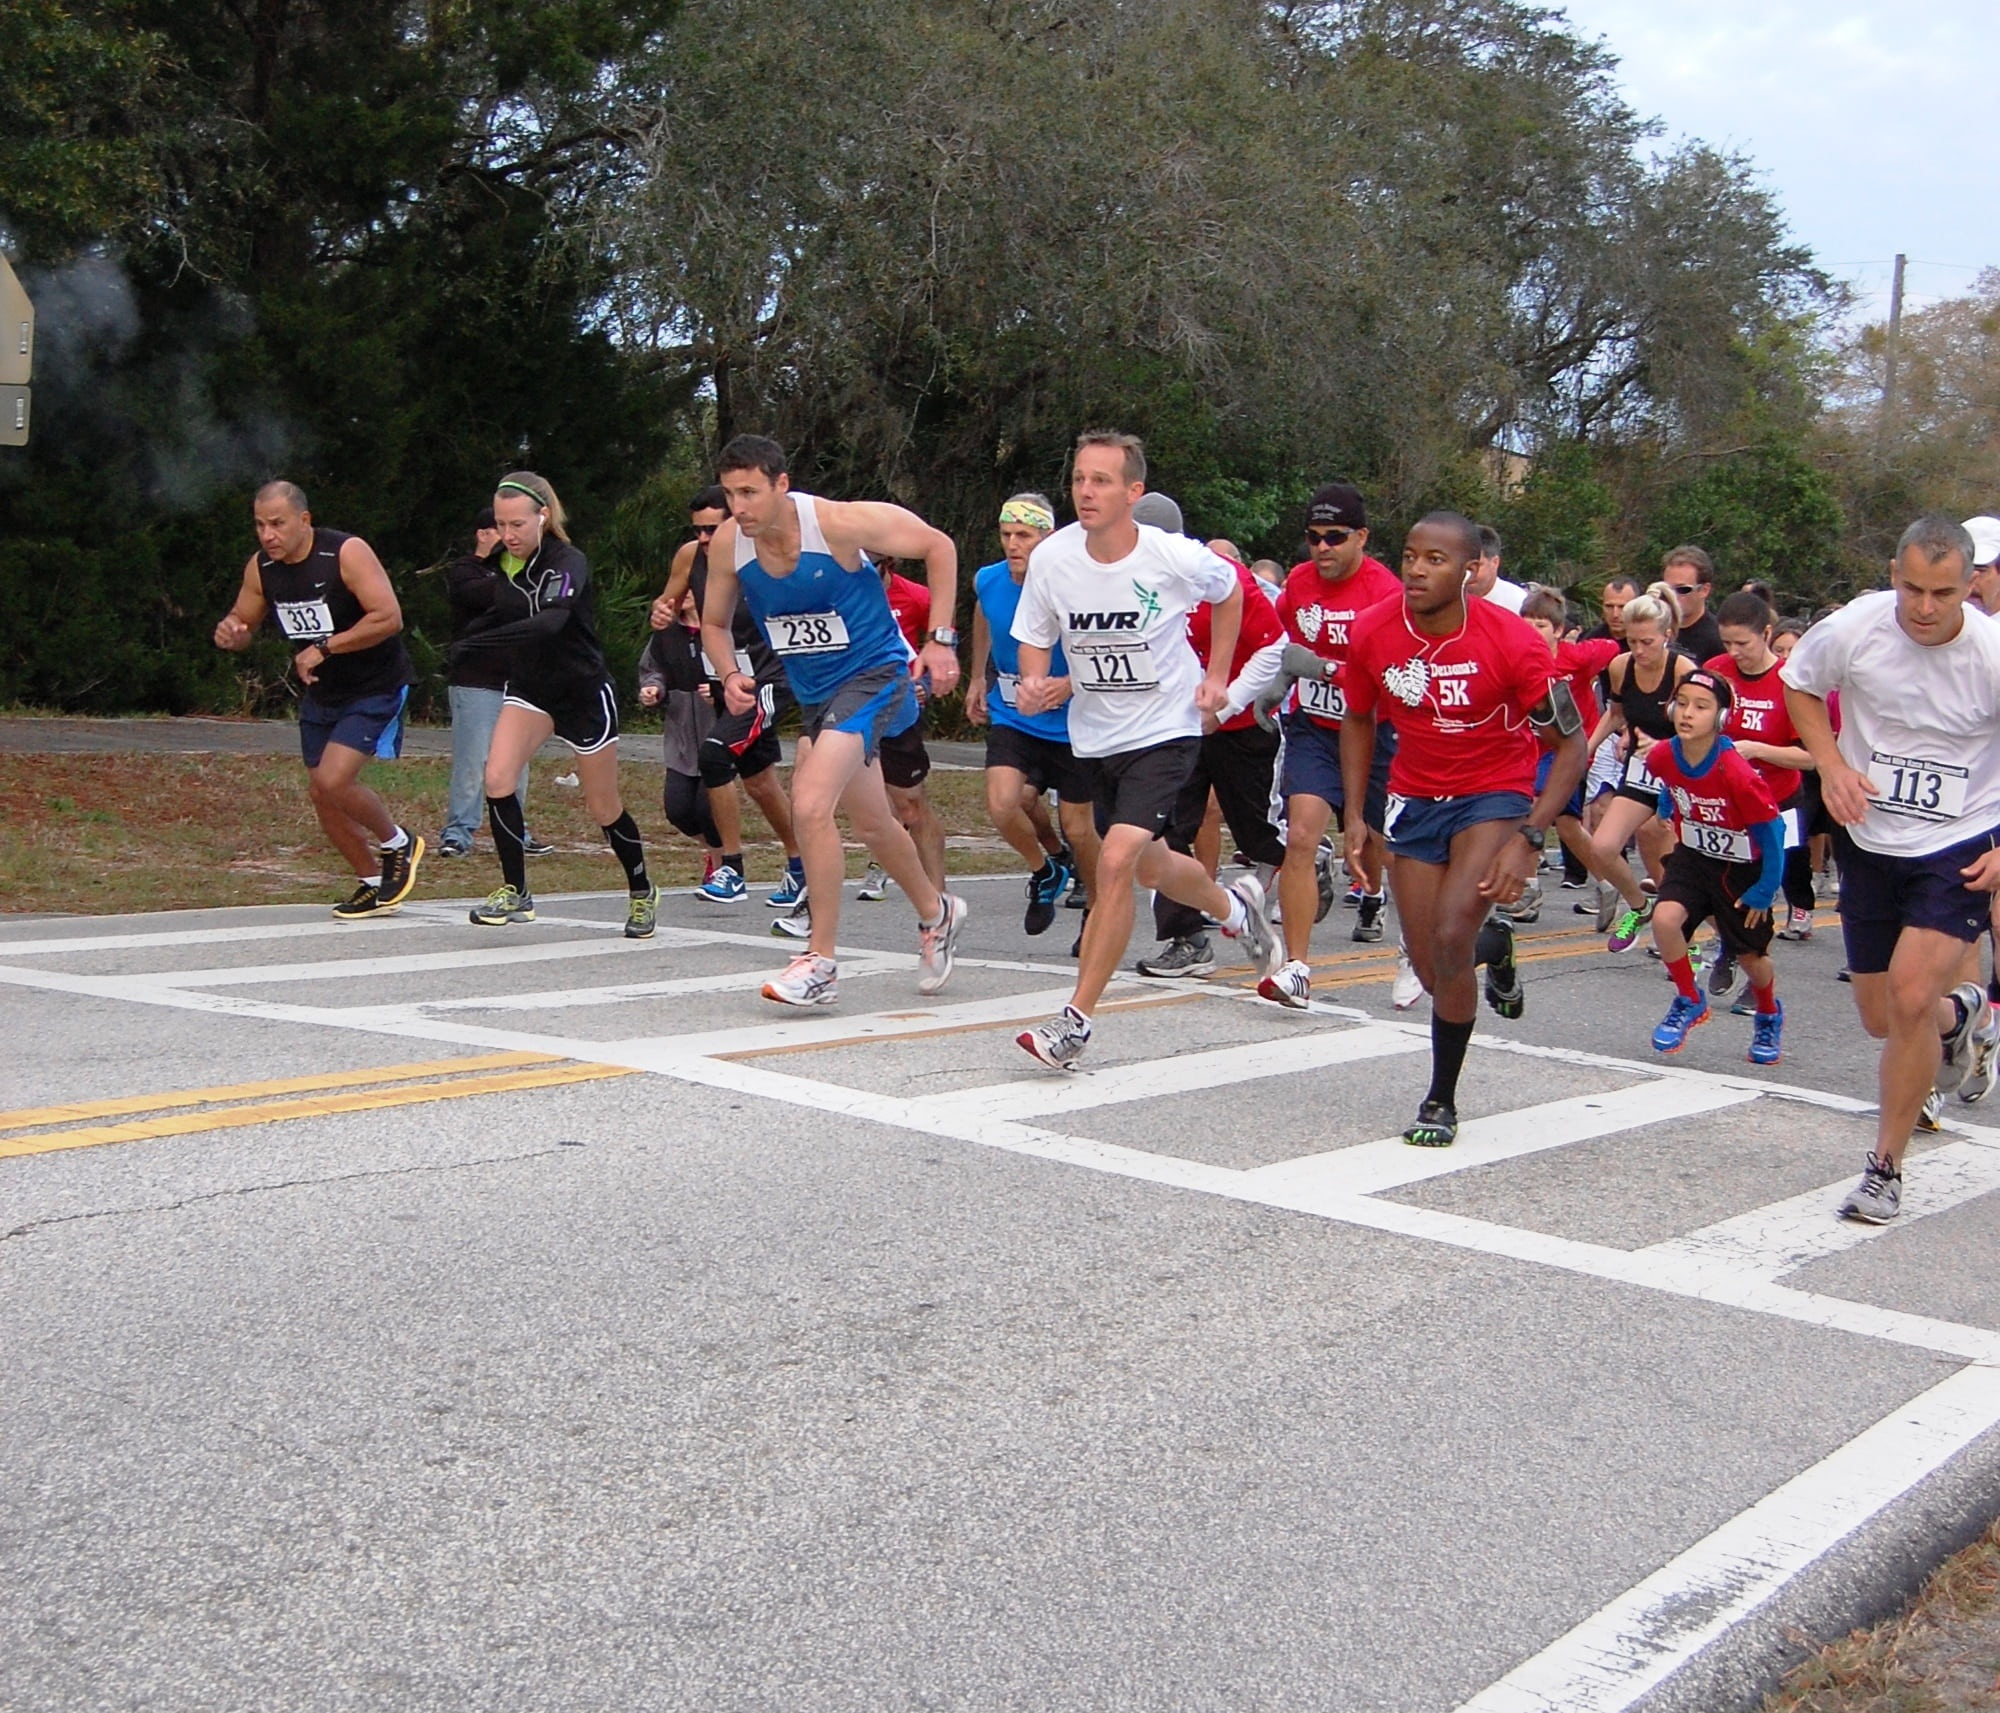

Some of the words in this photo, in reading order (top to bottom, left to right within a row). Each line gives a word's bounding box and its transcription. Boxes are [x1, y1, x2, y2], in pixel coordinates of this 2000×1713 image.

[287, 607, 321, 632] 313
[1069, 611, 1139, 630] WVR
[782, 619, 833, 647] 238
[1327, 623, 1349, 645] 5K
[1089, 654, 1139, 683] 121
[1308, 681, 1343, 714] 275
[1438, 680, 1471, 706] 5K
[1741, 711, 1763, 731] 5K
[1888, 768, 1942, 809] 113
[1699, 806, 1726, 823] 5K
[1694, 828, 1735, 856] 182
